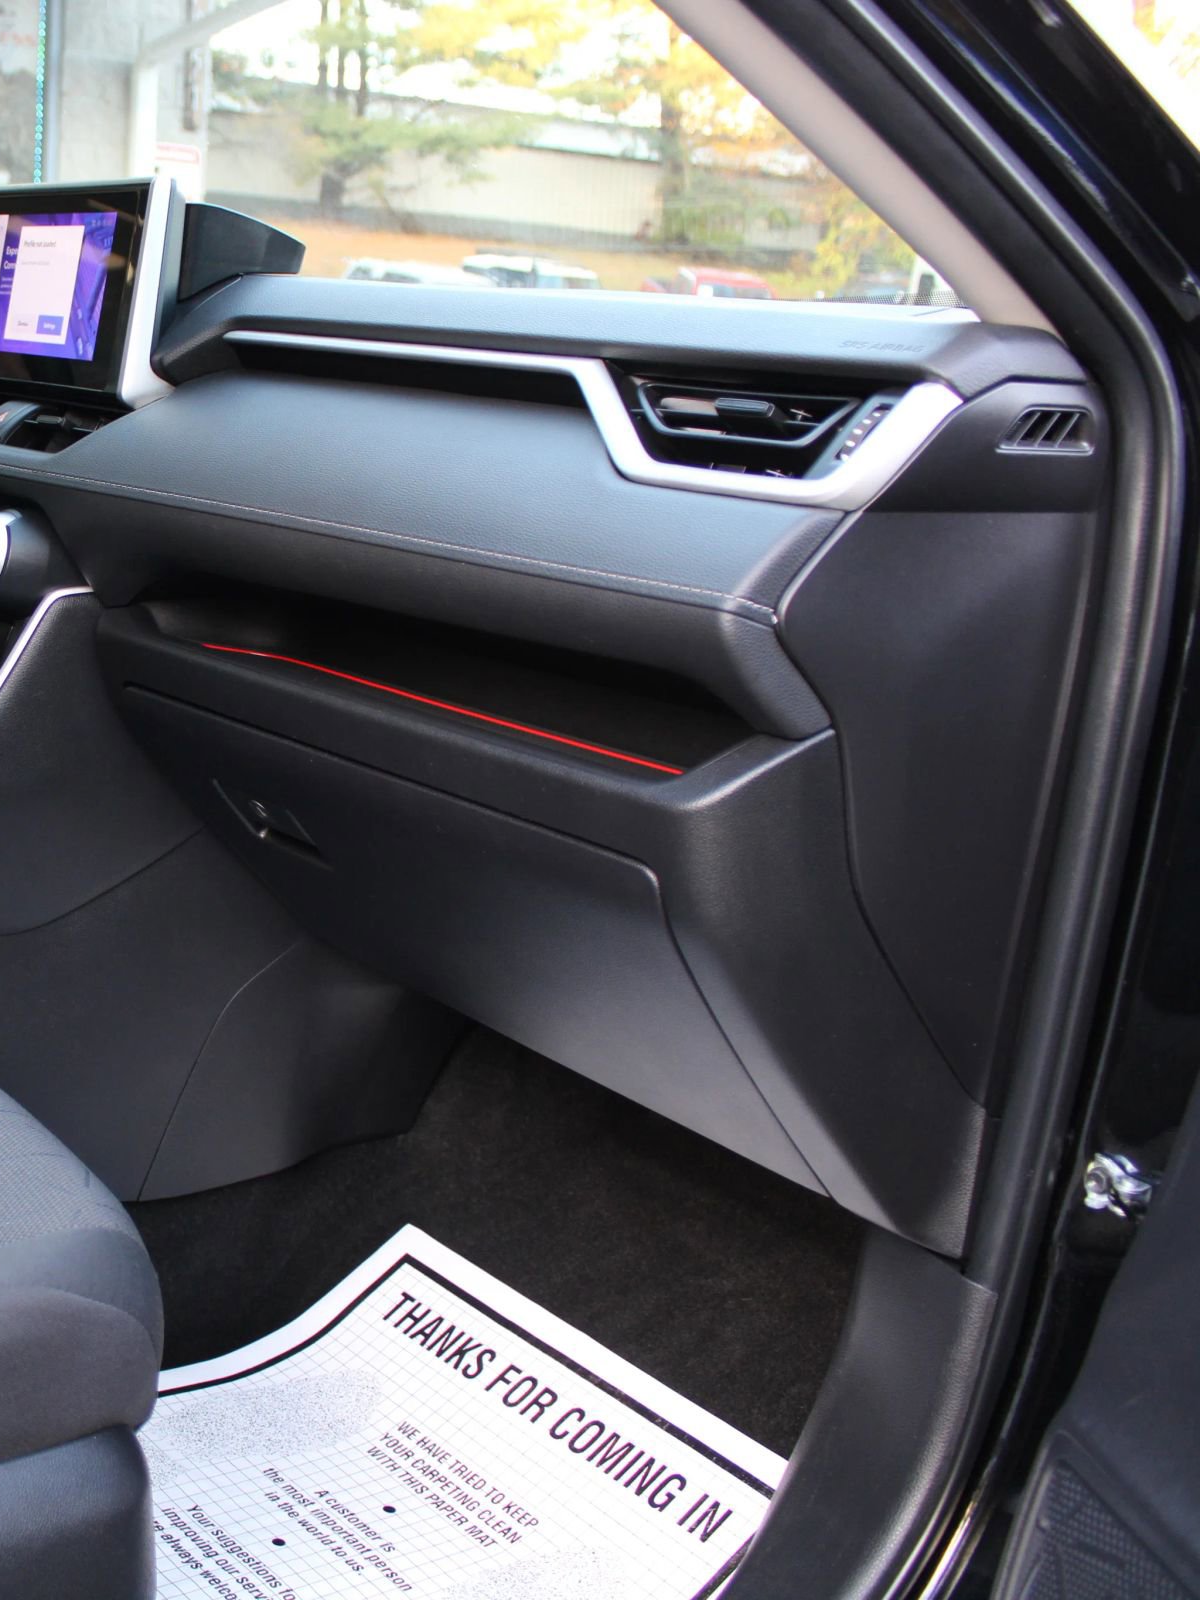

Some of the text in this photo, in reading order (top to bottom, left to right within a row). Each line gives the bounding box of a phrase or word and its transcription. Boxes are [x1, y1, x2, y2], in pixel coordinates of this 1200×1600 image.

[383, 1292, 733, 1543] THANKS FOR COMING IN
[314, 1490, 396, 1553] A customer is
[367, 1446, 498, 1548] WITH THIS PAPER MAT
[379, 1432, 522, 1544] YOUR CARPETING CLEAN
[397, 1421, 539, 1528] WE HAVE TRIED TO KEEP
[161, 1507, 273, 1600] improving our serv
[161, 1533, 203, 1570] always
[200, 1570, 238, 1600] welco
[187, 1504, 296, 1600] Your suggestions fo
[263, 1468, 413, 1591] the most important person
[264, 1491, 365, 1576] in the world to us.
